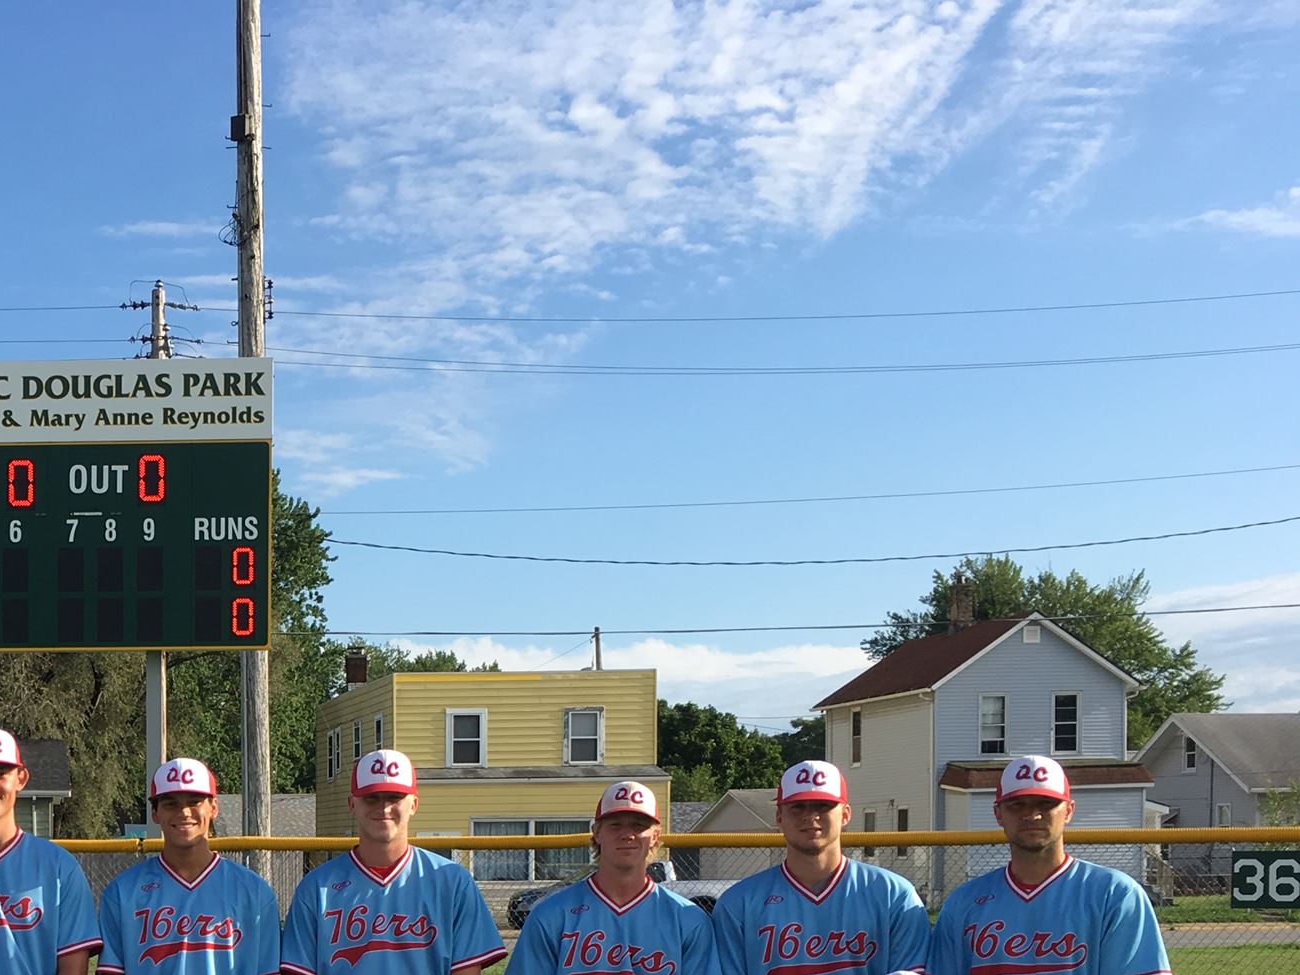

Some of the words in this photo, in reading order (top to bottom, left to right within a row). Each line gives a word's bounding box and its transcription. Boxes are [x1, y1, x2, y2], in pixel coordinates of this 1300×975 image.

[21, 373, 172, 400] DOUGLAS
[182, 371, 265, 397] PARK
[1, 409, 22, 427] &
[29, 409, 86, 431] Mary
[94, 408, 153, 426] Anne
[162, 406, 265, 430] Reynolds
[7, 459, 35, 507] 0
[69, 464, 129, 494] OUT
[137, 454, 165, 502] 0
[9, 519, 22, 543] 6
[66, 518, 79, 542] 7
[105, 518, 117, 542] 8
[143, 517, 155, 542] 9
[194, 516, 259, 541] RUNS
[232, 547, 254, 585] 0
[232, 598, 254, 636] 0
[1233, 859, 1300, 901] 36
[134, 905, 242, 943] 76ers
[324, 904, 437, 945] 76ers
[757, 922, 877, 963] 76ers
[561, 929, 677, 972] 76ers
